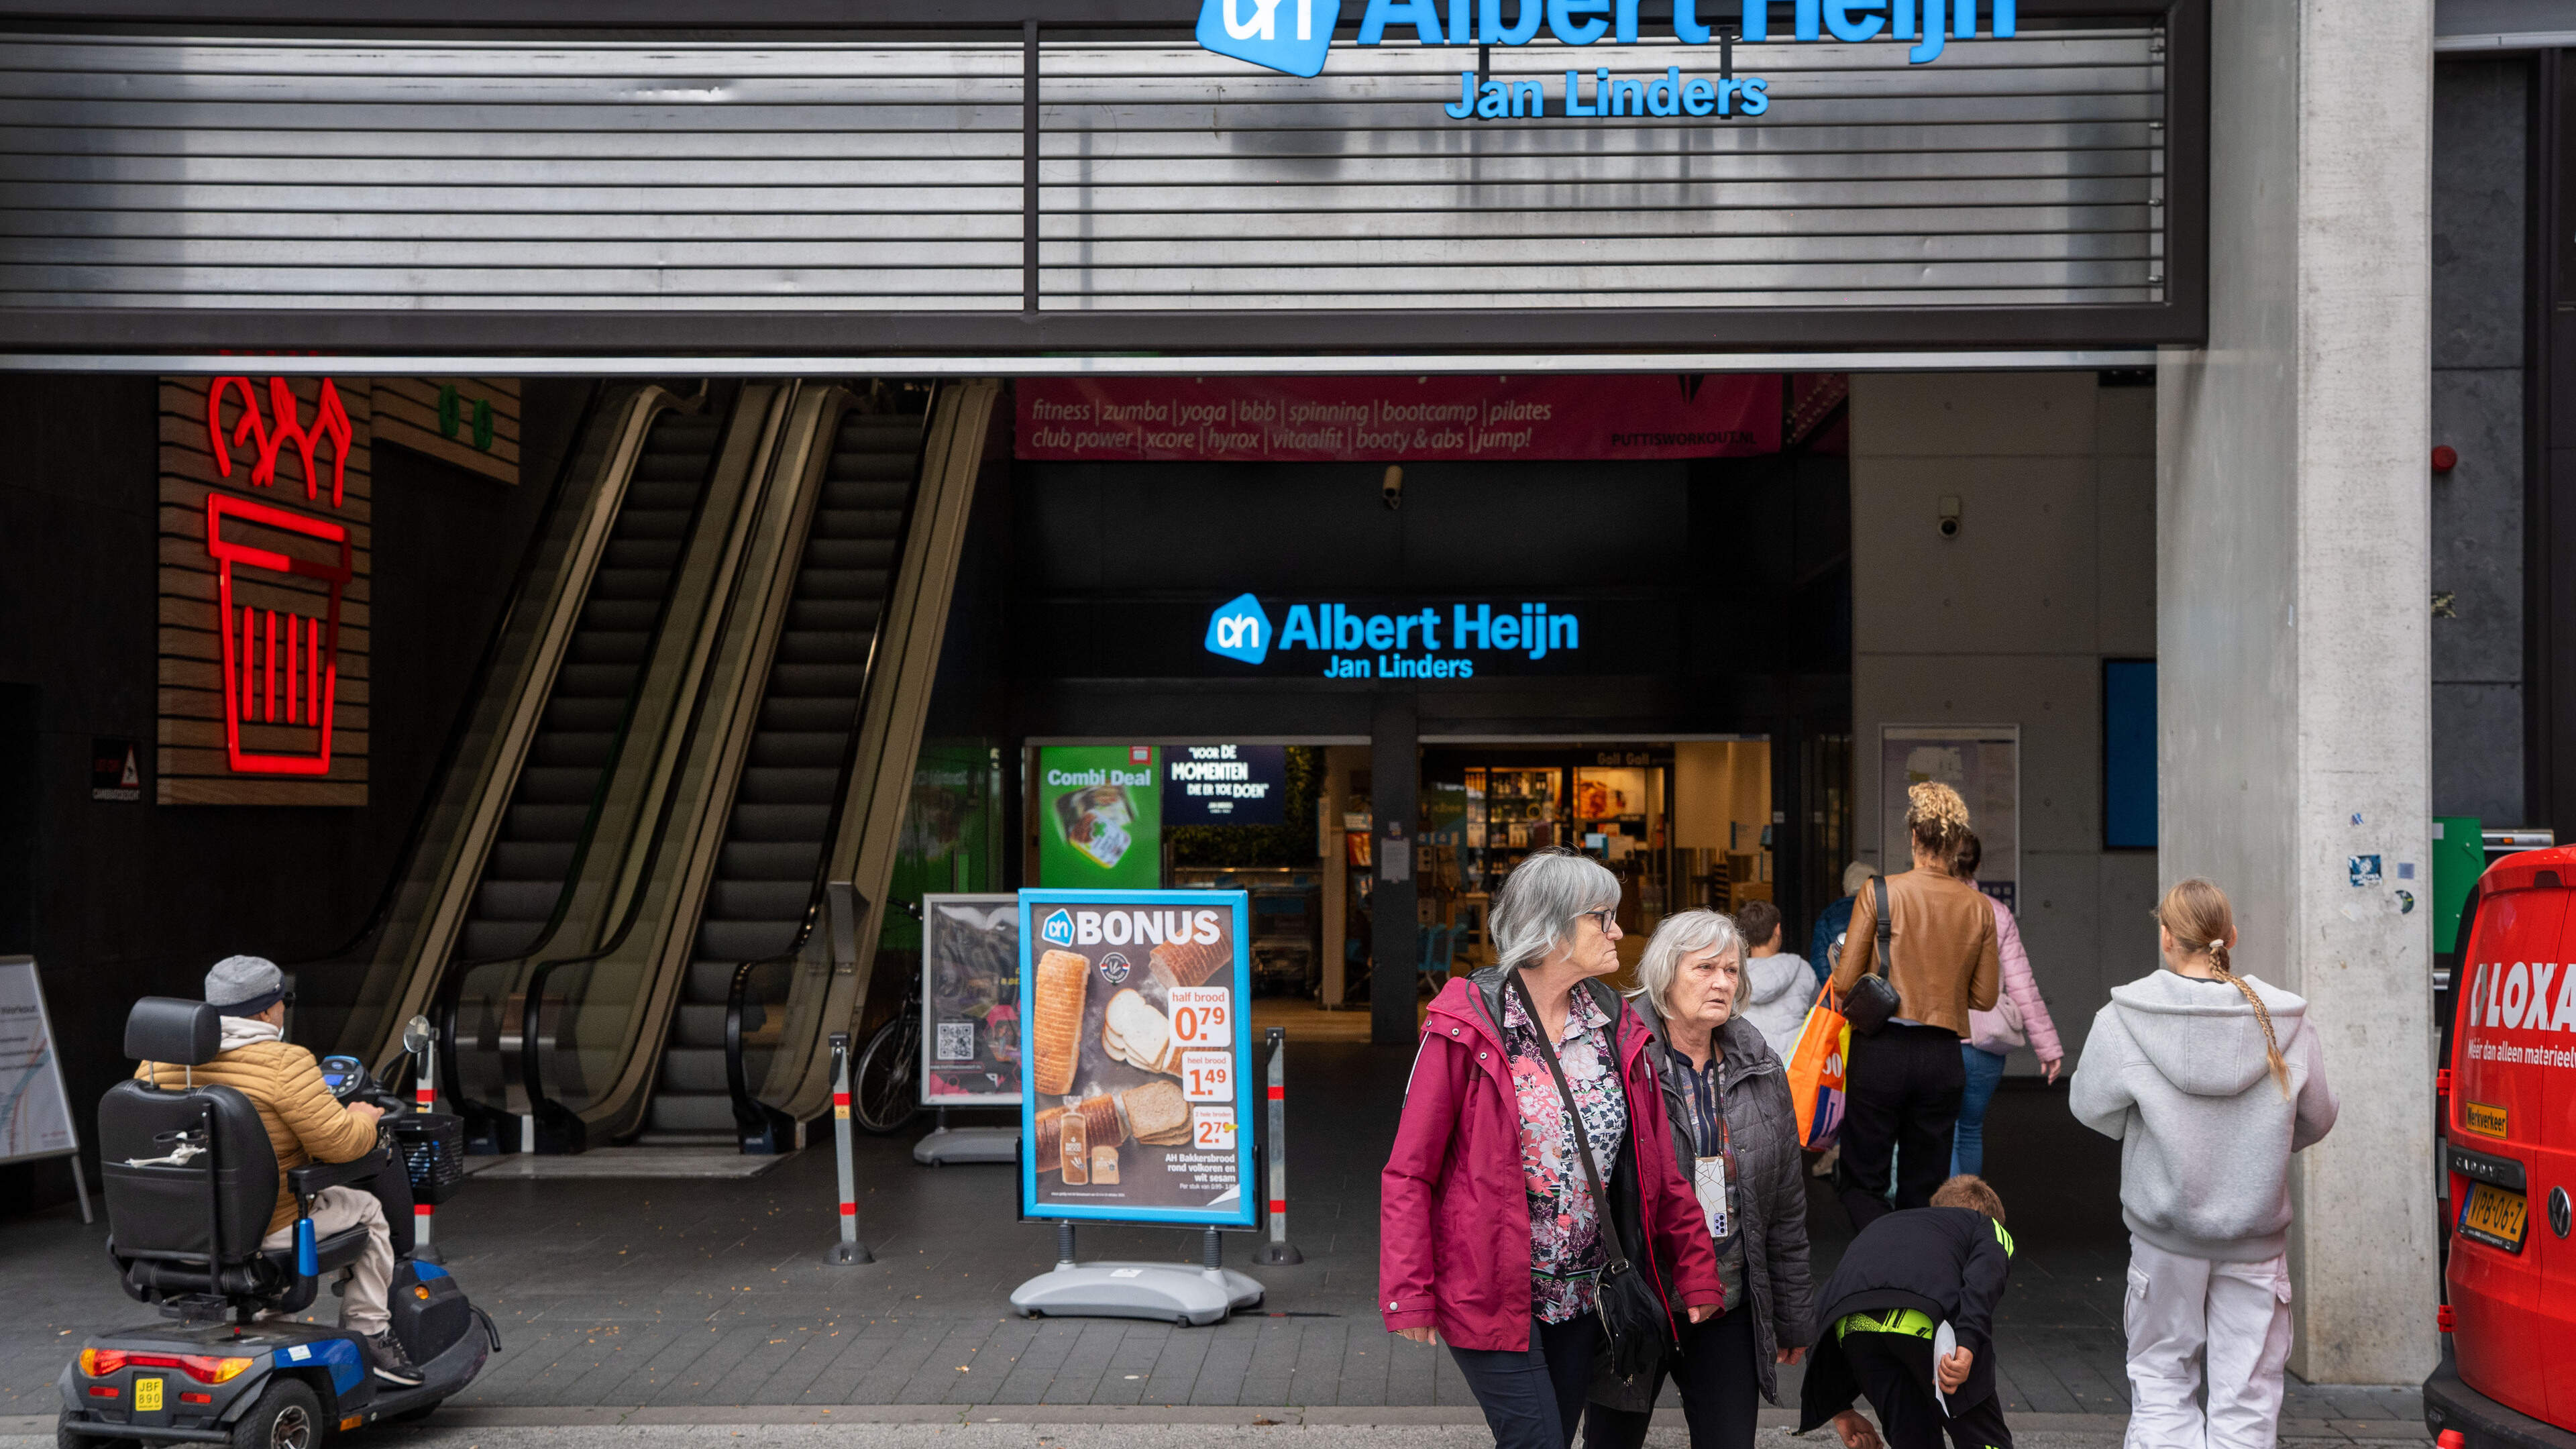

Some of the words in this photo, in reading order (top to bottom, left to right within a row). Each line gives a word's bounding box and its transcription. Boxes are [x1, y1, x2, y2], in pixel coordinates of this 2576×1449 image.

[1444, 70, 1544, 119] Jan
[1565, 66, 1769, 118] Linders
[1032, 398, 1090, 421] fitness
[1102, 399, 1167, 421] zumba
[1179, 404, 1227, 427] yoga
[1240, 399, 1276, 421] bbb
[1289, 401, 1369, 427] spinning
[1382, 400, 1479, 427] bootcamp
[1489, 400, 1552, 427] pilates
[1032, 427, 1071, 447] club
[1073, 431, 1133, 453] power
[1146, 433, 1195, 448] xcore
[1208, 427, 1259, 453] hyrox
[1273, 427, 1344, 448] vitaalfit
[1356, 427, 1411, 453] booty
[1413, 429, 1428, 448] &
[1430, 427, 1464, 449] abs
[1473, 427, 1532, 454] jump!
[1611, 431, 1758, 447] PUTTISWORKOUT.NL
[1278, 603, 1441, 650] Albert
[1453, 602, 1578, 659] Heijn
[1324, 655, 1371, 678] Jan
[1379, 654, 1473, 678] Linders
[1220, 745, 1237, 759] DE
[1048, 769, 1106, 786] Combi
[1110, 769, 1151, 786] Deal
[1171, 762, 1248, 781] MOMENTEN
[1187, 784, 1202, 796] DIE
[1216, 784, 1232, 796] TOE
[1077, 910, 1221, 945] BONUS
[1172, 992, 1191, 1002] half
[1194, 992, 1225, 1002] brood
[2486, 961, 2576, 1033] LOXA
[1175, 1007, 1225, 1040] 0.79
[2483, 1040, 2496, 1061] dan
[2497, 1040, 2522, 1063] alleen
[1189, 1069, 1226, 1095] 1.49
[2467, 1107, 2506, 1132] Werkverkeer
[1165, 1154, 1177, 1162] AH
[1179, 1154, 1235, 1163] Bakkersbrood
[1167, 1163, 1186, 1172] rond
[1188, 1163, 1223, 1173] volkoren
[1194, 1173, 1208, 1182] wit
[1210, 1174, 1236, 1182] sesam
[2471, 1188, 2524, 1234] VPB-06-Z
[140, 1381, 160, 1391] JBF
[139, 1393, 160, 1404] 890
